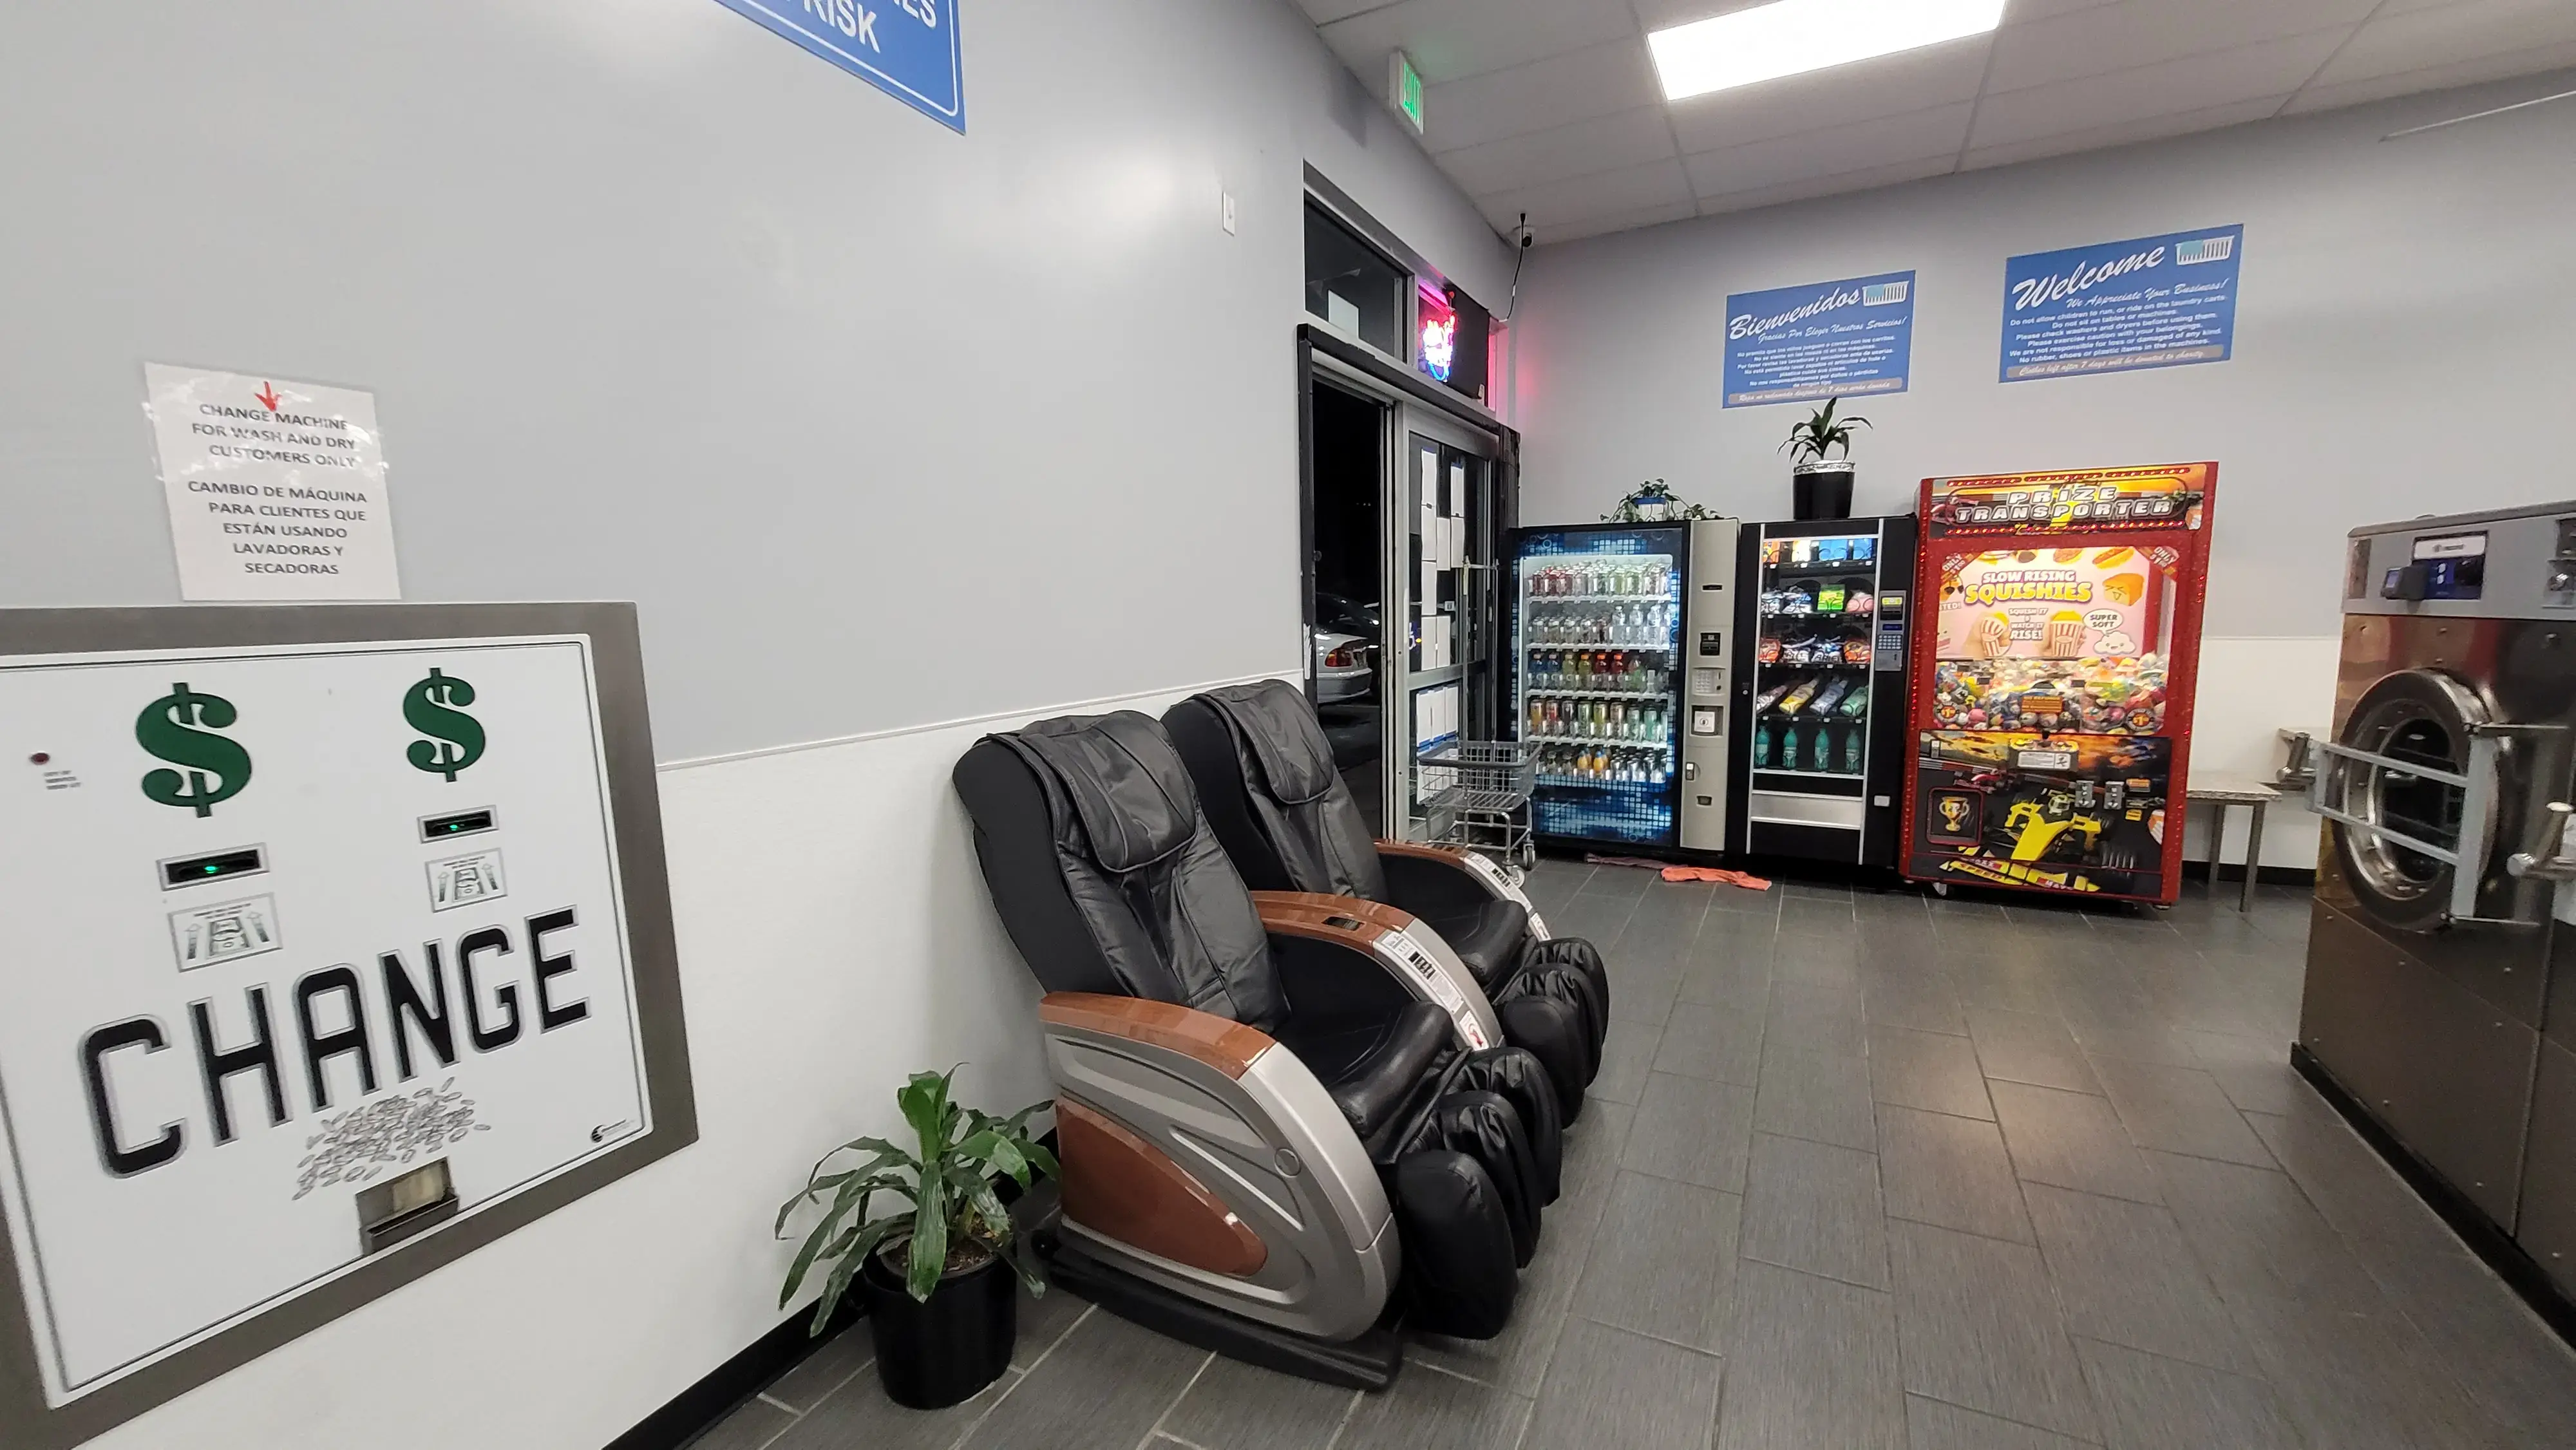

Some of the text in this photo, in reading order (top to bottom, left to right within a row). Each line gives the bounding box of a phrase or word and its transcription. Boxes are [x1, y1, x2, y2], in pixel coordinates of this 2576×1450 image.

[2012, 246, 2166, 311] Welcome
[2066, 278, 2229, 308] We Appreciate Your Business!
[2171, 298, 2202, 306] laundry
[1729, 287, 1861, 340] Bienvenidos
[1758, 316, 1907, 344] Gracias Por Elegir Nuestros Servicios!
[2049, 343, 2094, 352] responsible
[2137, 333, 2174, 343] damaged
[2093, 348, 2119, 357] plastic
[200, 406, 346, 429] CHANGE MACHINE
[192, 423, 354, 449] FOR WASH AND DRY
[209, 445, 355, 467] CUSTOMERS ONLY
[188, 481, 367, 502] CAMBIO DE MÁQUINA
[2008, 486, 2117, 505] PRIZE
[209, 502, 366, 521] PARA CLIENTES QUE
[1956, 498, 2174, 522] TRANSPORTER
[223, 523, 347, 538] ESTÁN USANDO
[234, 543, 343, 556] LAVADORAS Y
[2154, 546, 2177, 565] ONLY
[245, 563, 339, 574] SECADORAS
[1942, 554, 1962, 572] ONLY
[1982, 569, 2076, 583] SLOW RISING
[1964, 582, 2092, 606] SQUISHIES
[2009, 630, 2043, 641] RISE!
[79, 905, 592, 1179] CHANGE
